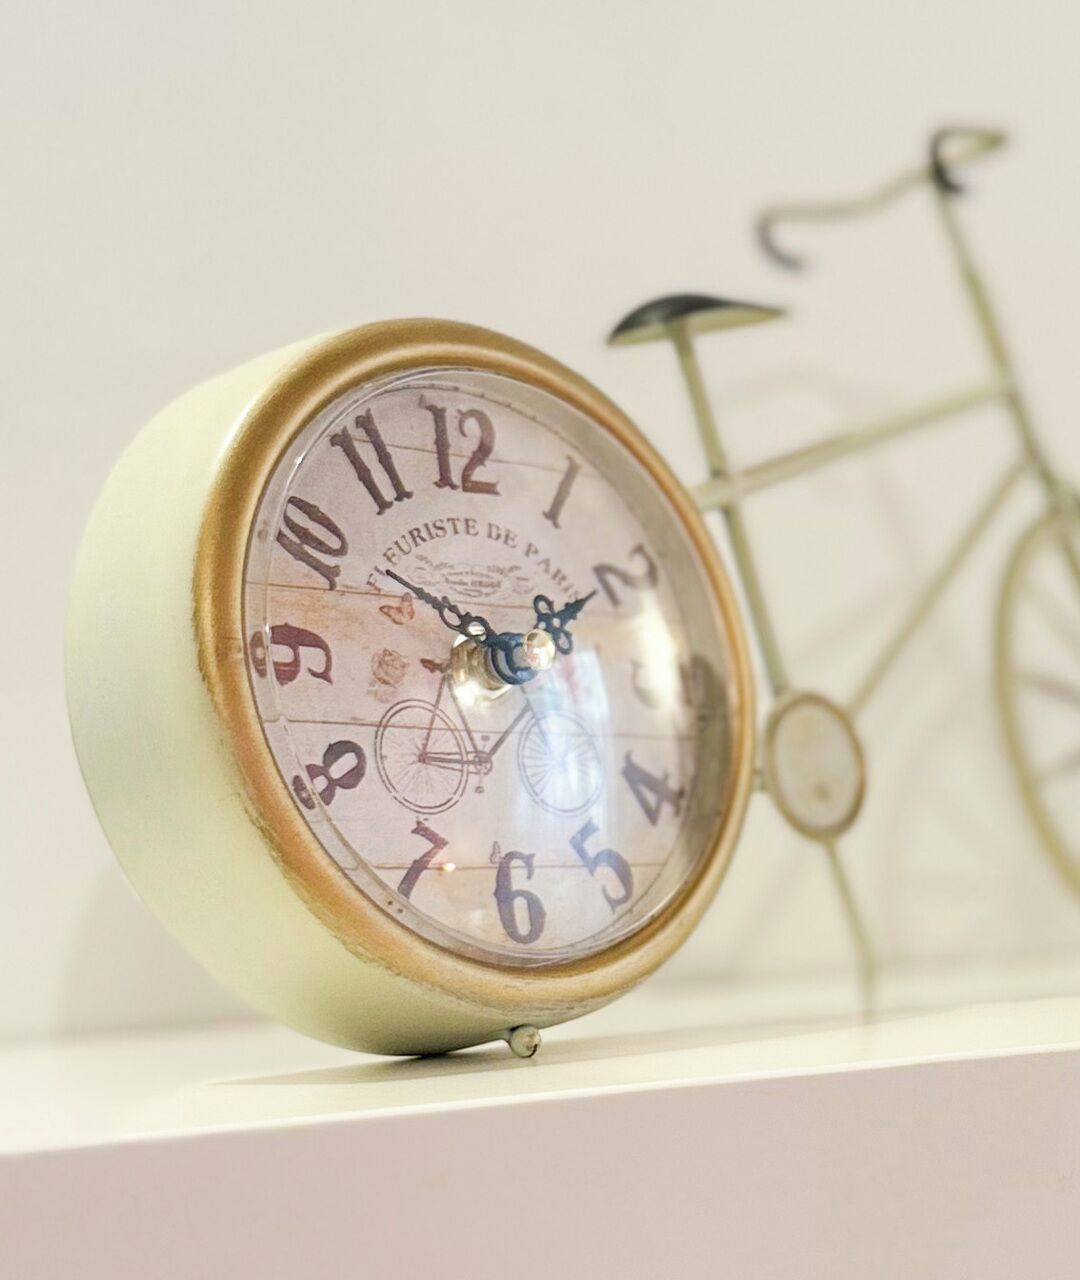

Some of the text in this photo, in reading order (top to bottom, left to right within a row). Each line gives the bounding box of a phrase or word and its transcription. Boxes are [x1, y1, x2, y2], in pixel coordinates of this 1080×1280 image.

[330, 407, 413, 515] 11
[419, 394, 501, 496] 12
[542, 455, 582, 529] 1
[276, 495, 349, 590] 10
[487, 522, 518, 549] DE
[592, 543, 659, 607] 2
[249, 622, 333, 685] 9
[293, 739, 367, 811] 8
[621, 750, 686, 827] 4
[398, 815, 450, 900] 7
[493, 840, 547, 945] 6
[569, 822, 635, 912] 5
